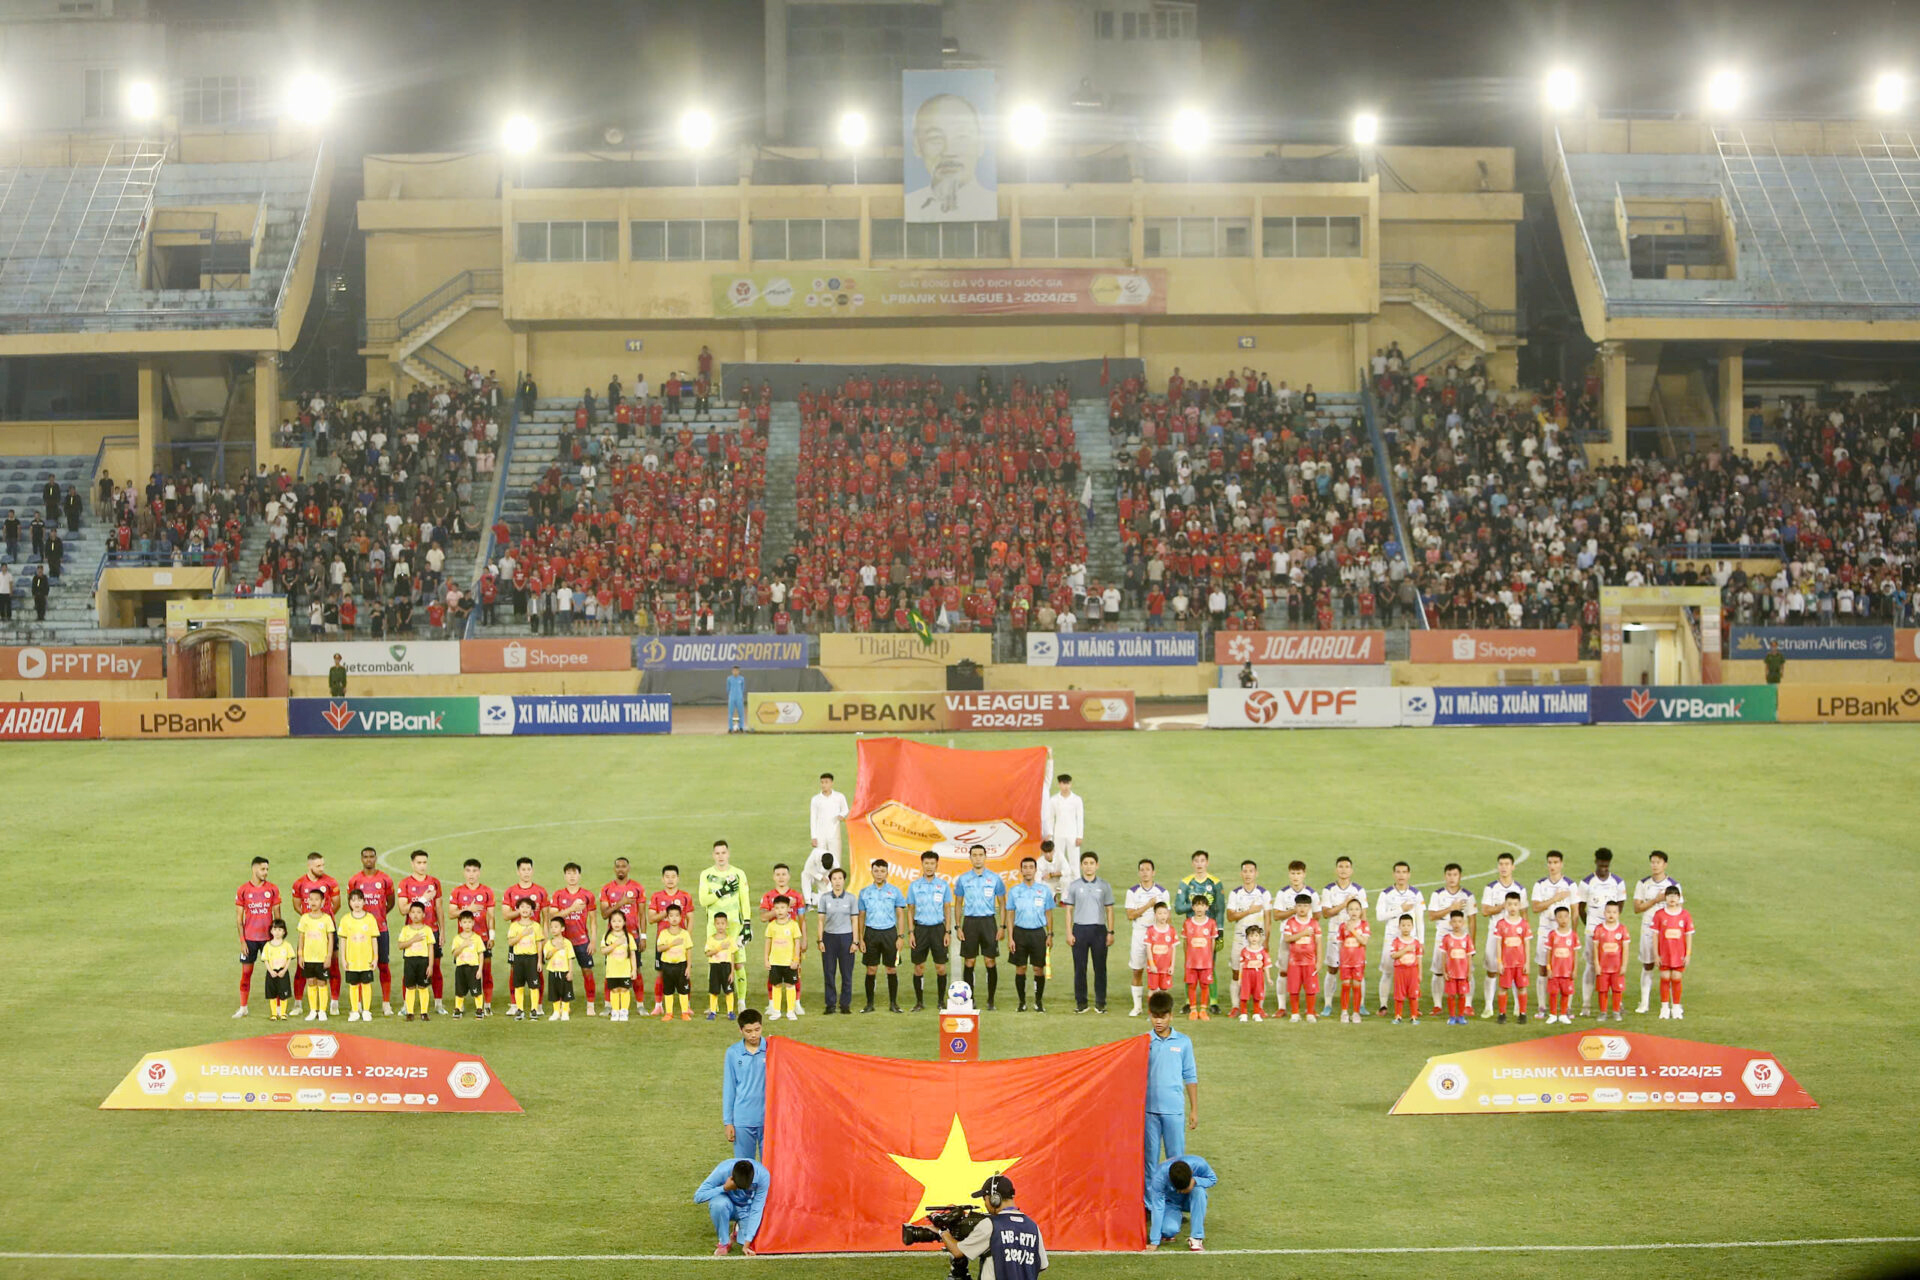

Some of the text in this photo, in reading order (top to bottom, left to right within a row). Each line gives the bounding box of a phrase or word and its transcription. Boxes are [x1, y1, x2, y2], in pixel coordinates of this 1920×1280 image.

[882, 293, 936, 304] LPBANK
[939, 293, 1003, 304] V.LEAGUE
[1023, 292, 1077, 303] 2024/25
[672, 642, 802, 662] DONGLUCSPORT.VN
[1062, 635, 1196, 657] XI MĂNG XUÂN THÀNH
[1259, 635, 1372, 660] JOGARBOLA
[1479, 642, 1536, 660] Shopee
[1763, 636, 1868, 650] Vetnam Airlines
[51, 653, 142, 678] FPT Play
[342, 661, 415, 673] ietcombank
[530, 649, 588, 668] Shopee
[518, 698, 670, 724] XI MĂNG XUÂN THÀNH
[944, 694, 1071, 711] V.LEAGUE 1
[1283, 690, 1357, 715] VPF
[1439, 689, 1588, 715] XI MĂNG XUÂN THÀNH
[1659, 698, 1742, 719] VPBank
[1817, 697, 1900, 716] LPBank
[0, 707, 84, 734] ARBOLA
[358, 710, 443, 731] VPBank
[828, 703, 936, 721] LPBANK
[972, 713, 1044, 728] 2024/25
[140, 713, 225, 733] LPBank
[201, 1064, 264, 1077] LPBANK
[267, 1065, 342, 1077] V.LEAGUE
[345, 1066, 353, 1077] 1
[365, 1066, 428, 1078] 2024/25
[1493, 1066, 1557, 1079] LPBANK
[1560, 1065, 1636, 1078] V.LEAGUE
[1639, 1066, 1648, 1077] 1
[1659, 1065, 1722, 1078] 2024/25
